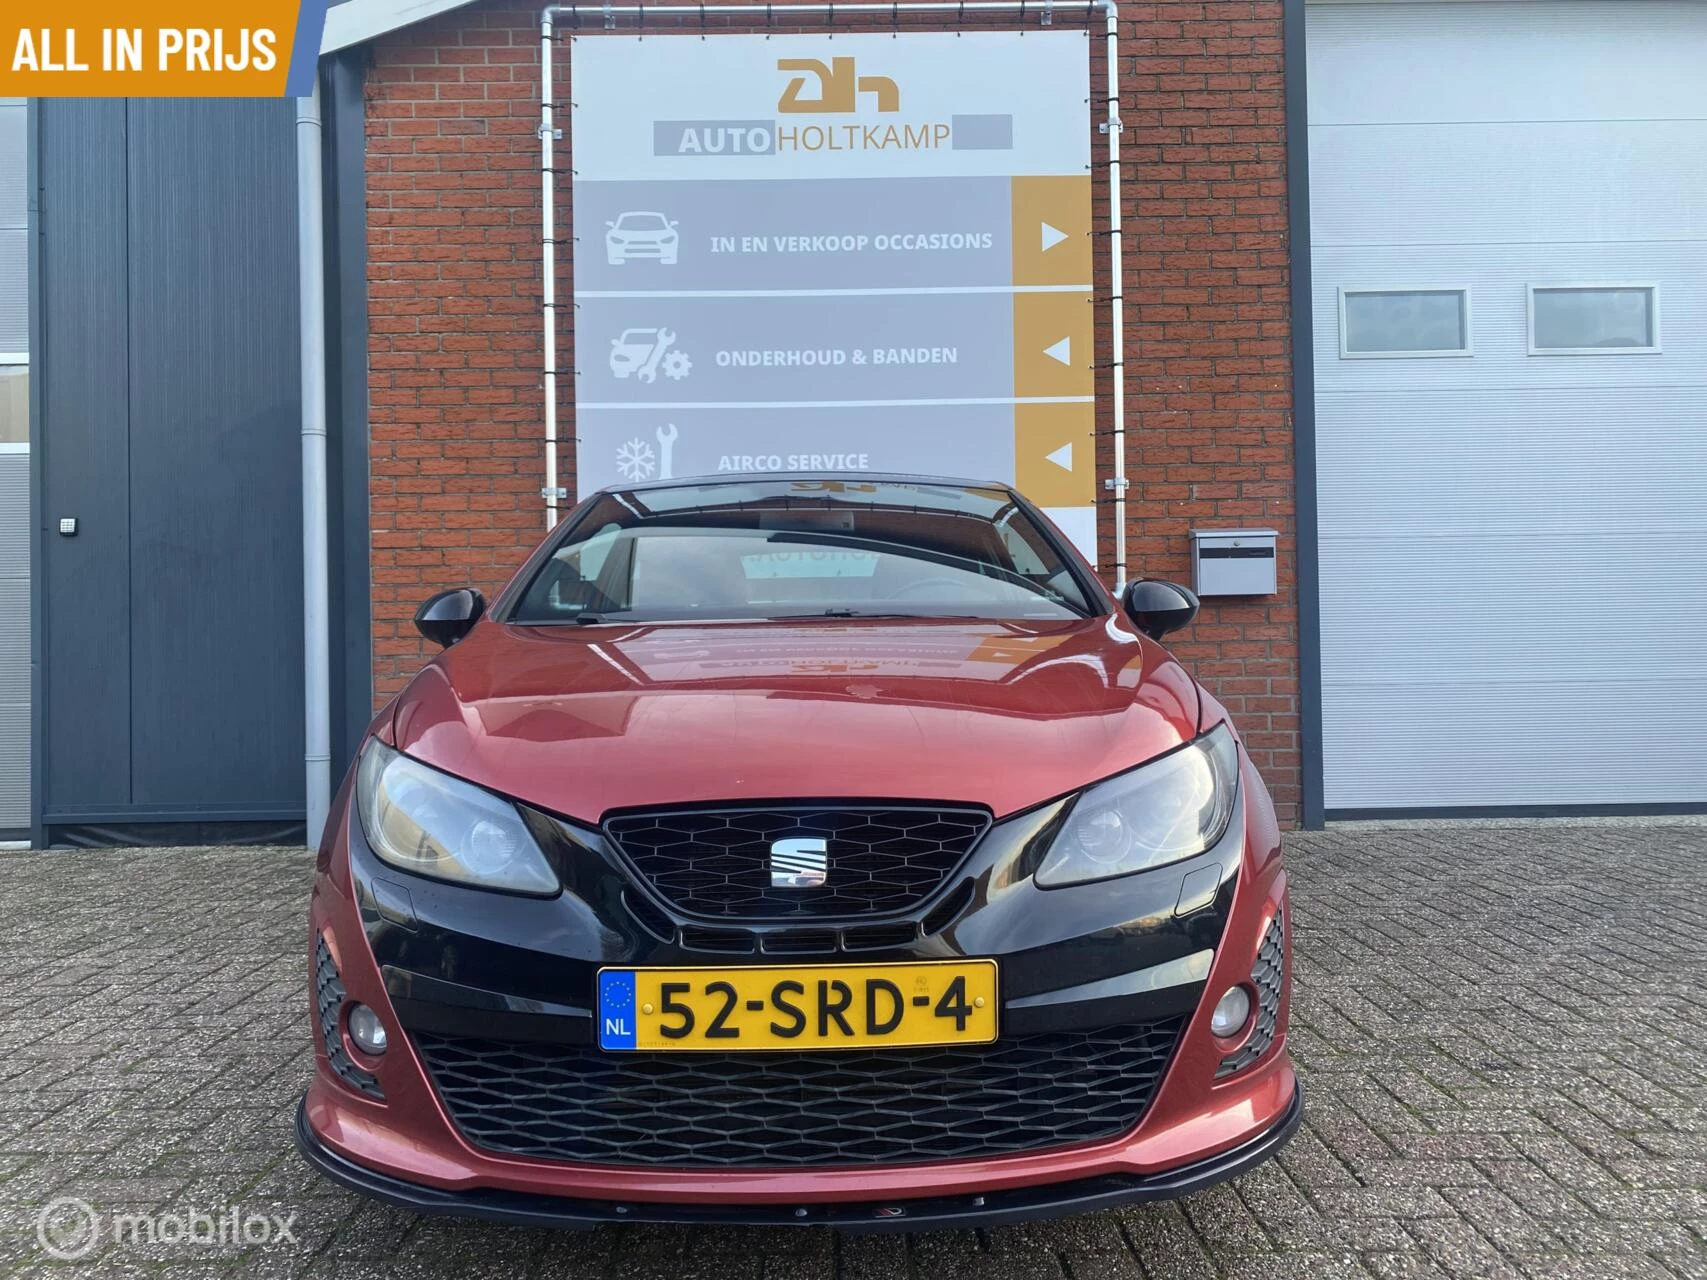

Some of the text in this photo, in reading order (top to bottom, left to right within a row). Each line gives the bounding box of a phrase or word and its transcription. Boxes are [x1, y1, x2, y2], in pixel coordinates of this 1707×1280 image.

[710, 232, 993, 253] IN EN VERKOOP OCCASIONS
[715, 347, 958, 367] ONDERHOUD & BANDEN
[718, 453, 869, 471] AIRCO SERVICE
[659, 975, 973, 1039] 52-SRD-4
[606, 1018, 631, 1036] NL
